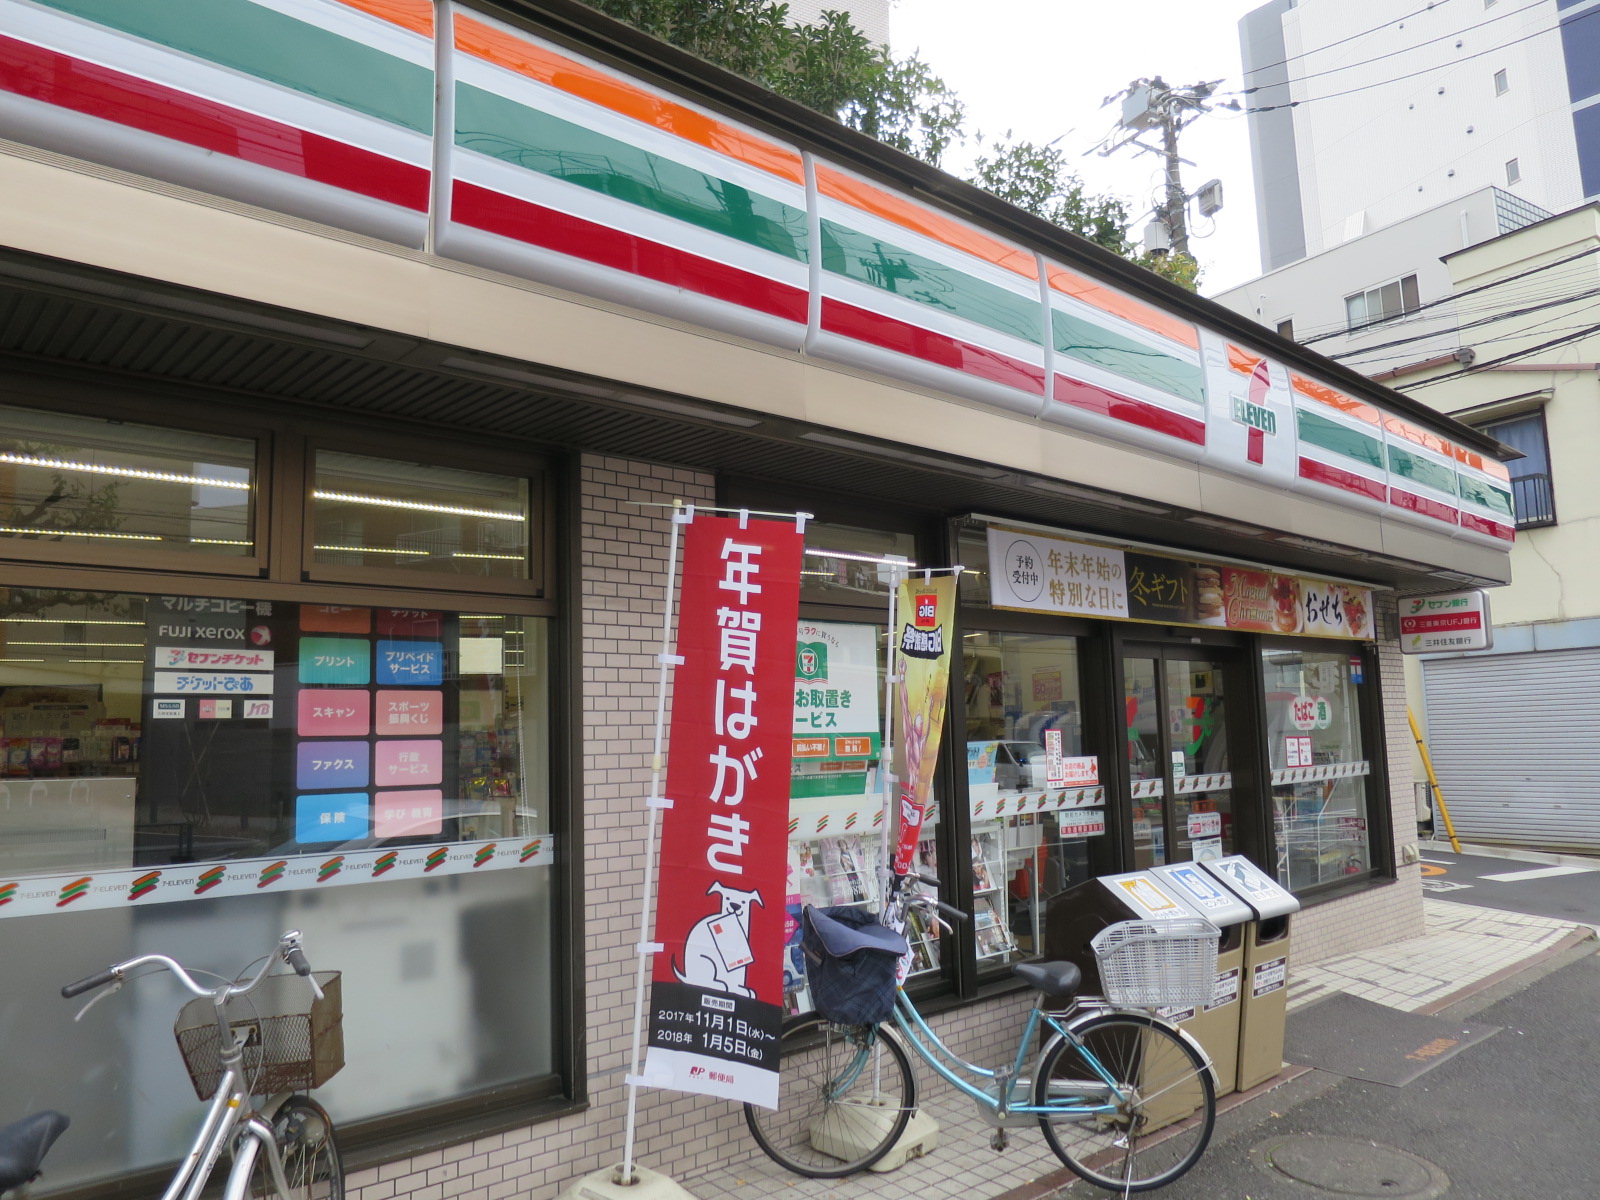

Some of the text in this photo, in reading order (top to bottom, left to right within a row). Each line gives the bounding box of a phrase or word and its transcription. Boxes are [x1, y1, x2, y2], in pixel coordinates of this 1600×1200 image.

[1016, 555, 1033, 570] 予約
[1047, 548, 1122, 581] 年末年始の
[1012, 570, 1039, 586] 受付中
[1129, 565, 1188, 606] 冬ギフト
[1049, 579, 1124, 610] 特別な日に
[161, 597, 272, 616] マルチコピー機
[1306, 591, 1342, 626] おせち
[1428, 598, 1468, 609] セブン銀行
[1419, 617, 1477, 628] 三菱東京UFJ銀行
[159, 625, 245, 640] FUJI xerox
[1425, 637, 1471, 647] 三井住友銀行
[188, 652, 264, 666] セブンチケット
[314, 656, 355, 667] プリント
[385, 651, 434, 662] プリペイド
[389, 663, 431, 674] サービス
[177, 676, 253, 691] チケットぴあ
[795, 689, 852, 708] お取置き
[246, 702, 270, 717] JTB
[312, 707, 355, 718] スキャン
[388, 702, 430, 712] スポーツ
[706, 538, 763, 875] 年賀はがき
[1293, 701, 1327, 721] たばこ 酒
[388, 713, 429, 724] 振興くじ
[398, 751, 421, 763] 行政
[312, 758, 355, 771] ファクス
[388, 764, 430, 775] サービス
[319, 811, 346, 824] 保険
[384, 808, 406, 821] 学び
[703, 997, 734, 1010] 販売期間
[657, 1029, 763, 1060] 2018年 1月5日(金)
[708, 1071, 734, 1084] 郵便局
